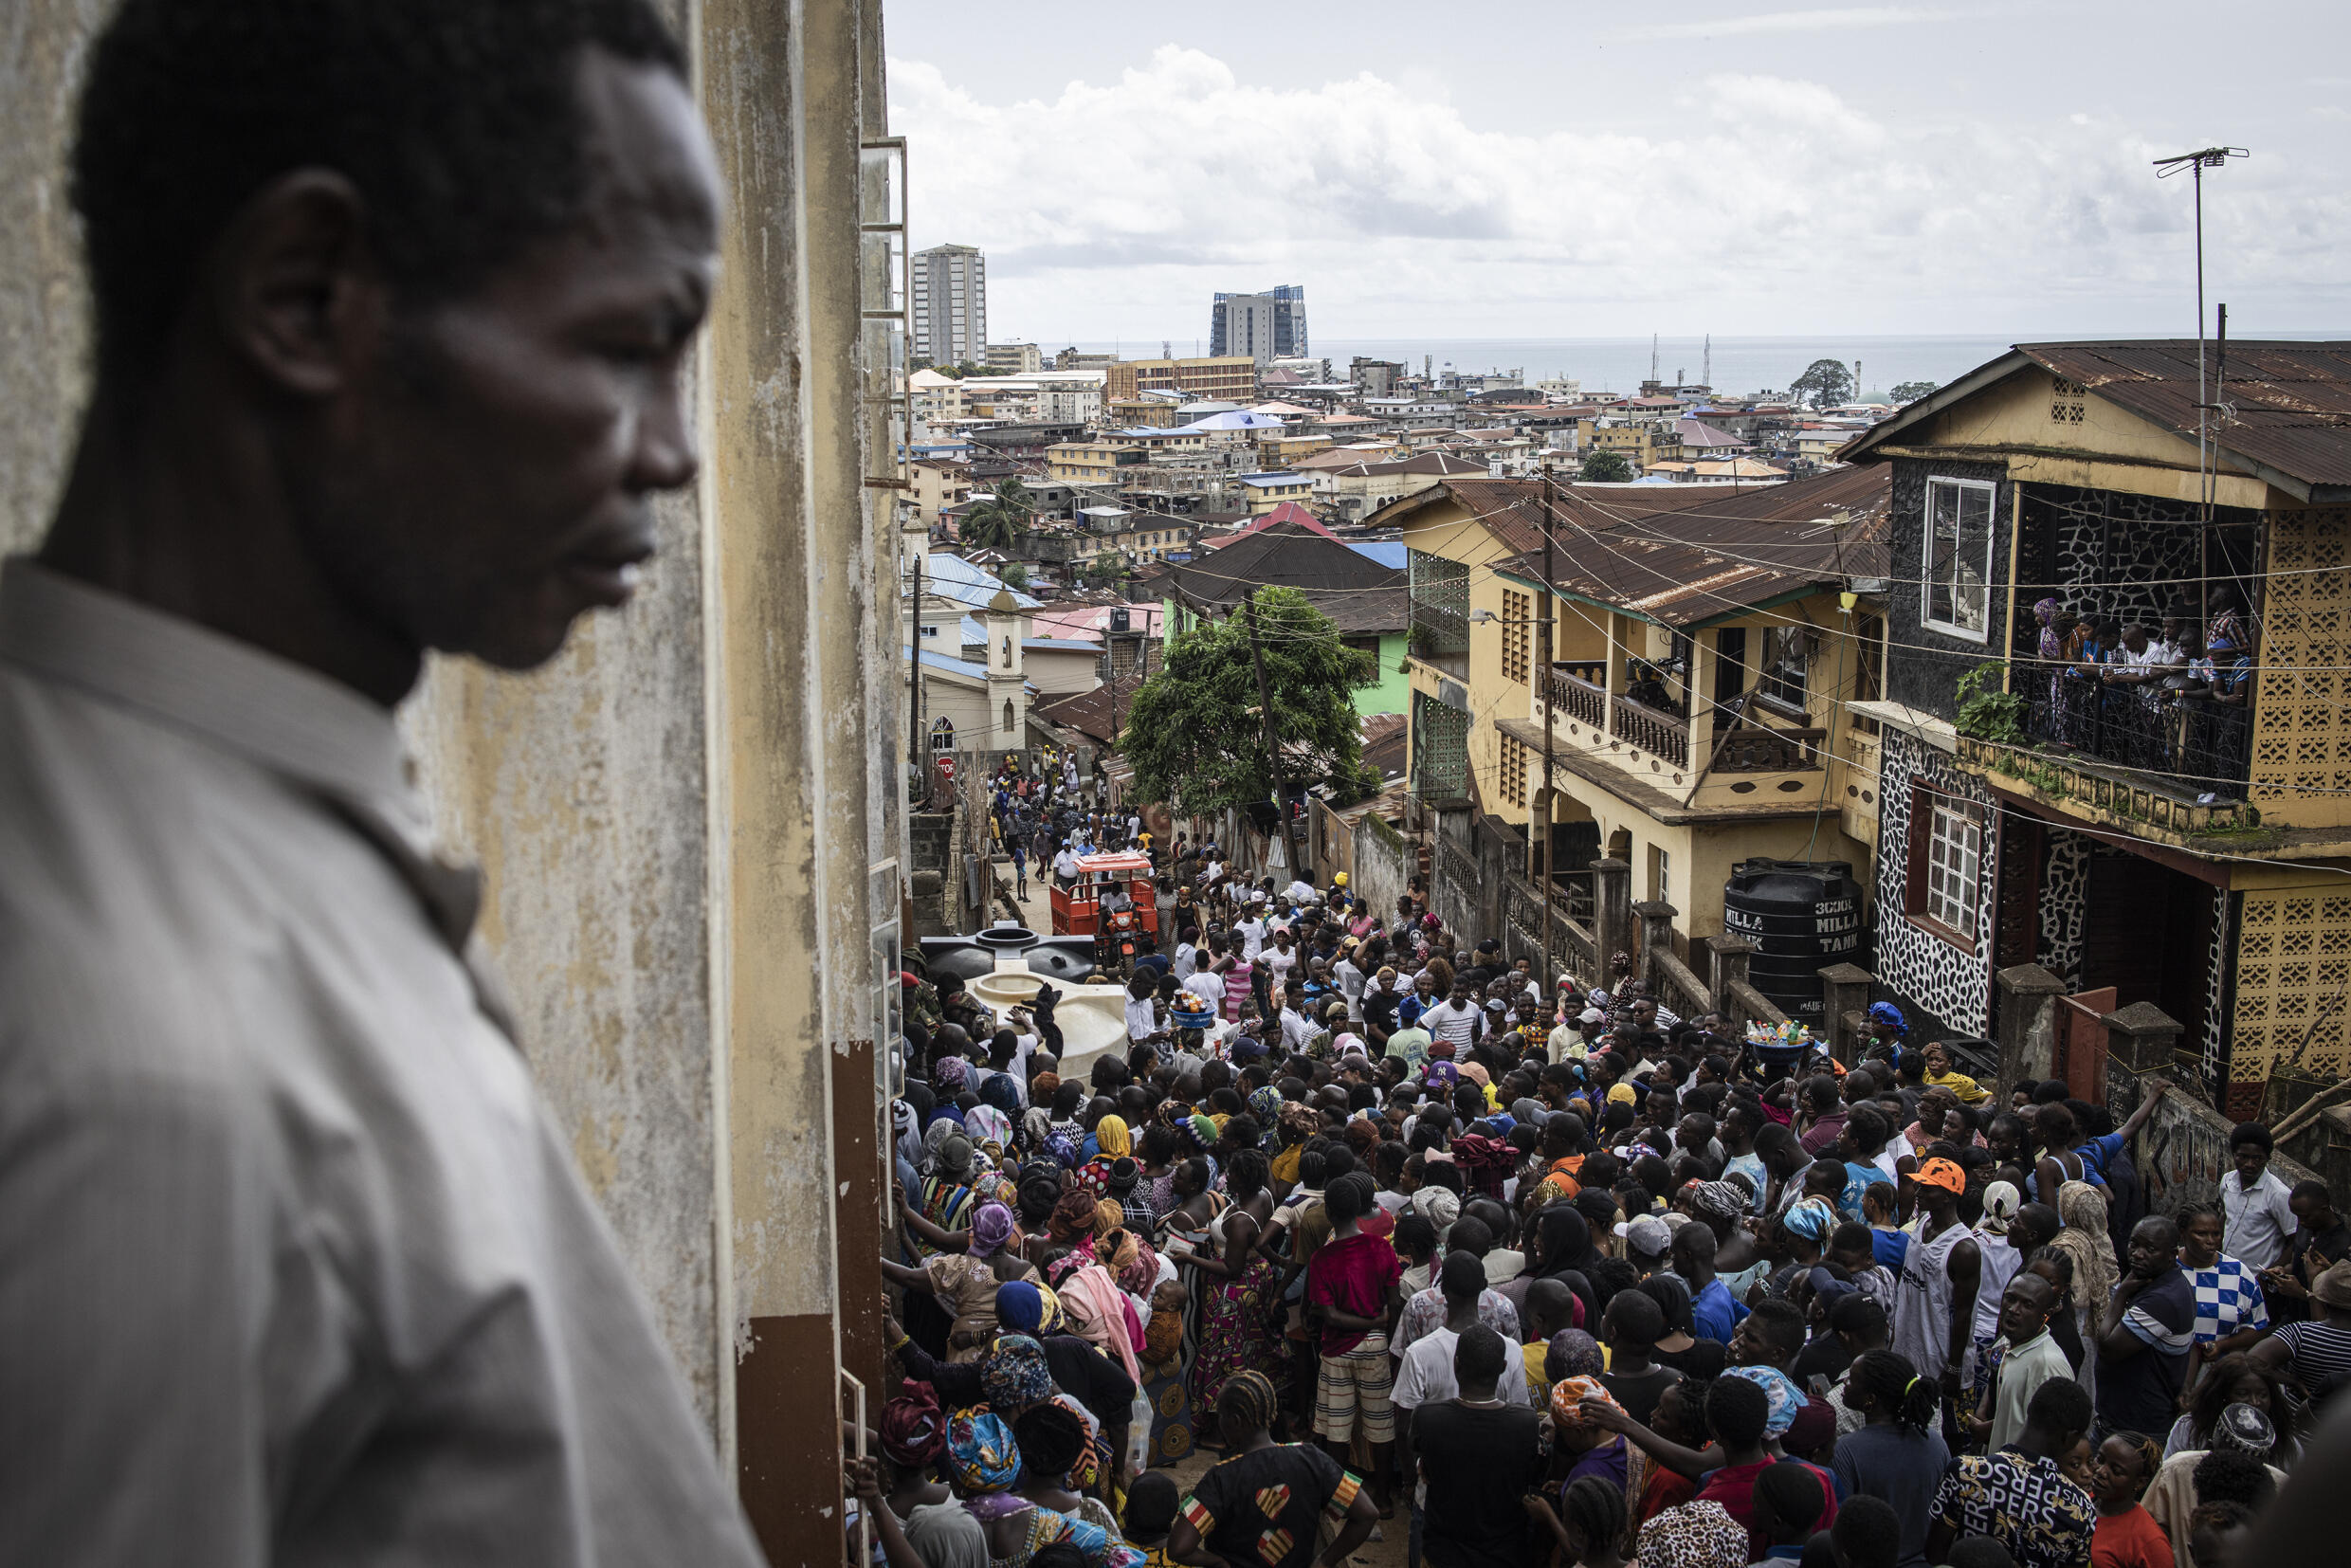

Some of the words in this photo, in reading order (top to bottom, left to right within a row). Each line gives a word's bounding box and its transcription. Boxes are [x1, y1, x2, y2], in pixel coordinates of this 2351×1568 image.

[939, 763, 954, 774] TOP
[1726, 908, 1763, 931] MILLA
[1816, 913, 1858, 934] MILLA
[1819, 933, 1858, 954] TANK
